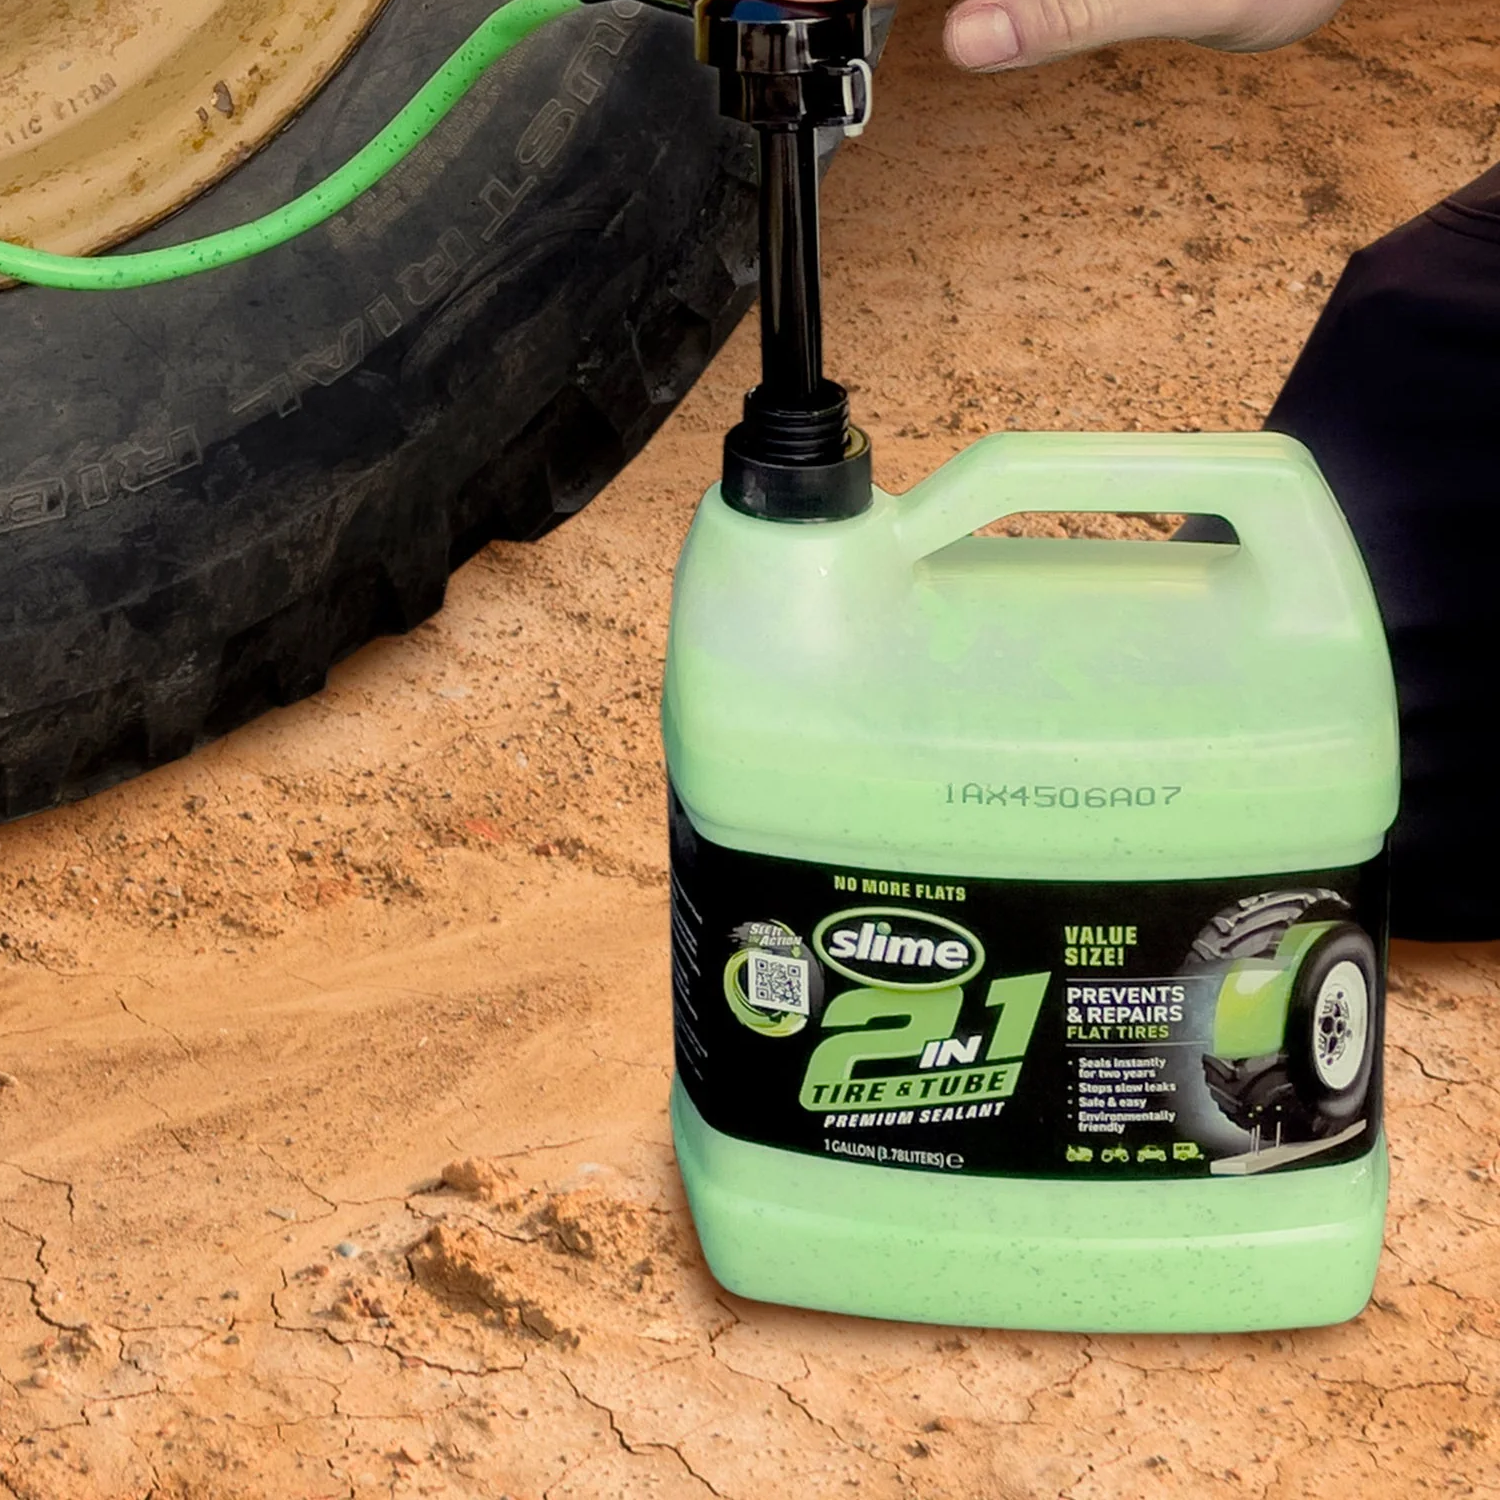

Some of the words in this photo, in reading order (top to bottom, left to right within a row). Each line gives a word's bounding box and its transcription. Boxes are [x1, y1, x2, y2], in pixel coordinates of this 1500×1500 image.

[834, 875, 857, 892] NO
[862, 878, 910, 898] MORE
[915, 883, 966, 901] FLATS
[1064, 926, 1137, 945] VALUE
[828, 921, 969, 970] slime
[1064, 947, 1124, 966] SIZE!
[1066, 986, 1185, 1004] PREVENTS
[1066, 1006, 1082, 1023] &
[1087, 1005, 1183, 1023] REPAIRS
[800, 986, 964, 1090] 2
[919, 1035, 983, 1069] IN
[985, 971, 1052, 1061] 1
[1067, 1025, 1111, 1039] FLAT
[1116, 1025, 1169, 1039] TIRES
[1078, 1057, 1112, 1068] Seals
[1078, 1068, 1096, 1078] for
[1098, 1069, 1121, 1078] two
[1122, 1069, 1156, 1080] years
[812, 1082, 887, 1104] TIRE
[896, 1081, 912, 1097] &
[920, 1070, 1008, 1099] TUBE
[1078, 1082, 1113, 1094] Stops
[1114, 1082, 1143, 1093] slow
[1144, 1082, 1176, 1092] leaks
[1078, 1097, 1105, 1108] Safe
[1107, 1097, 1117, 1107] &
[1118, 1099, 1147, 1109] easy
[823, 1111, 914, 1128] PREMIUM
[918, 1102, 1005, 1124] SEALANT
[1078, 1111, 1176, 1123] Environmentally
[1078, 1122, 1125, 1134] friendly
[831, 1139, 876, 1159] GALLON
